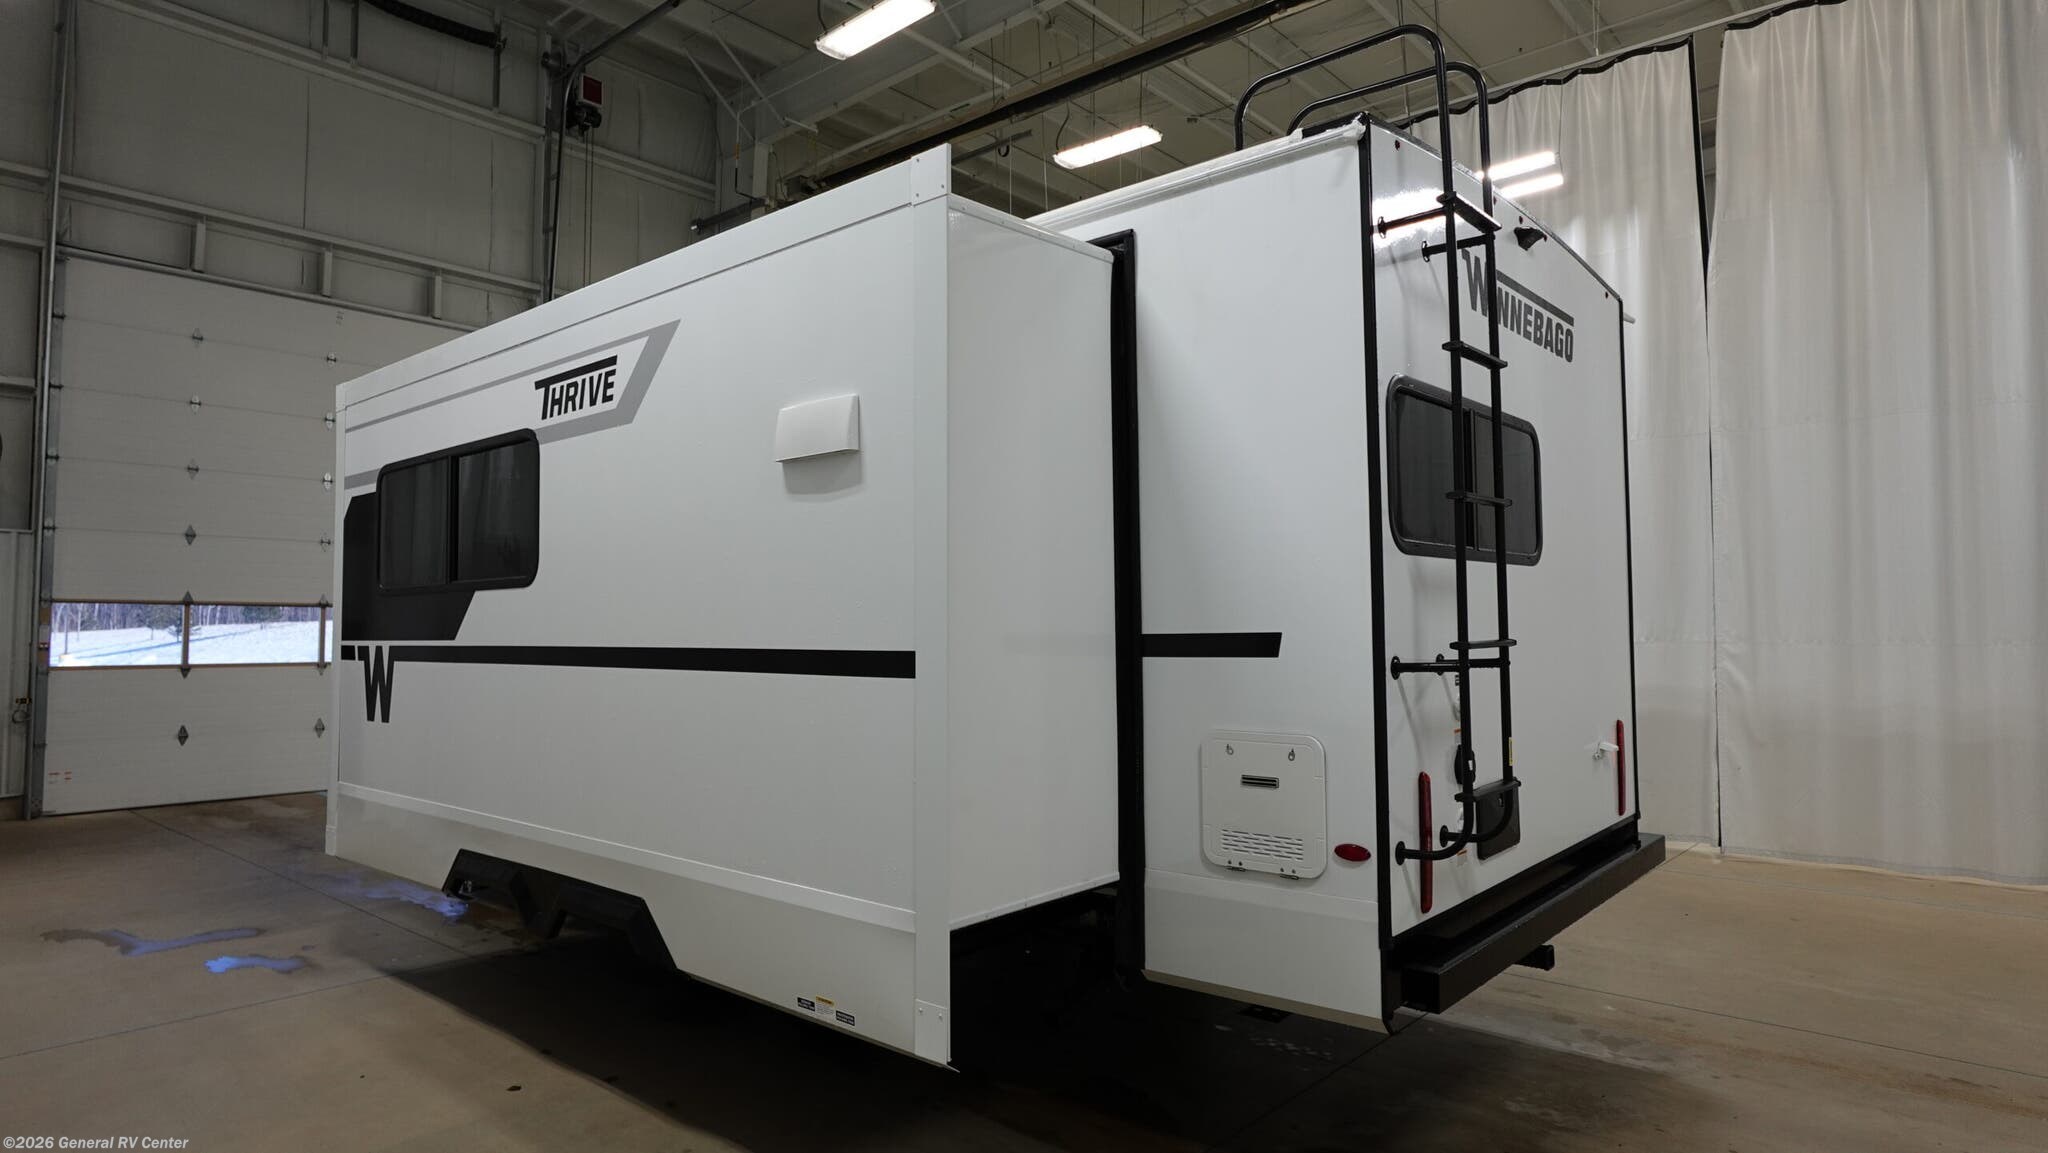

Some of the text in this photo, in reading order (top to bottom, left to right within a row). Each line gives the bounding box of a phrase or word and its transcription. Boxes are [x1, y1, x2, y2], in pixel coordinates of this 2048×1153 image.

[1461, 248, 1574, 363] WNNEBAGO
[534, 354, 618, 421] THRIVE
[357, 645, 395, 723] W
